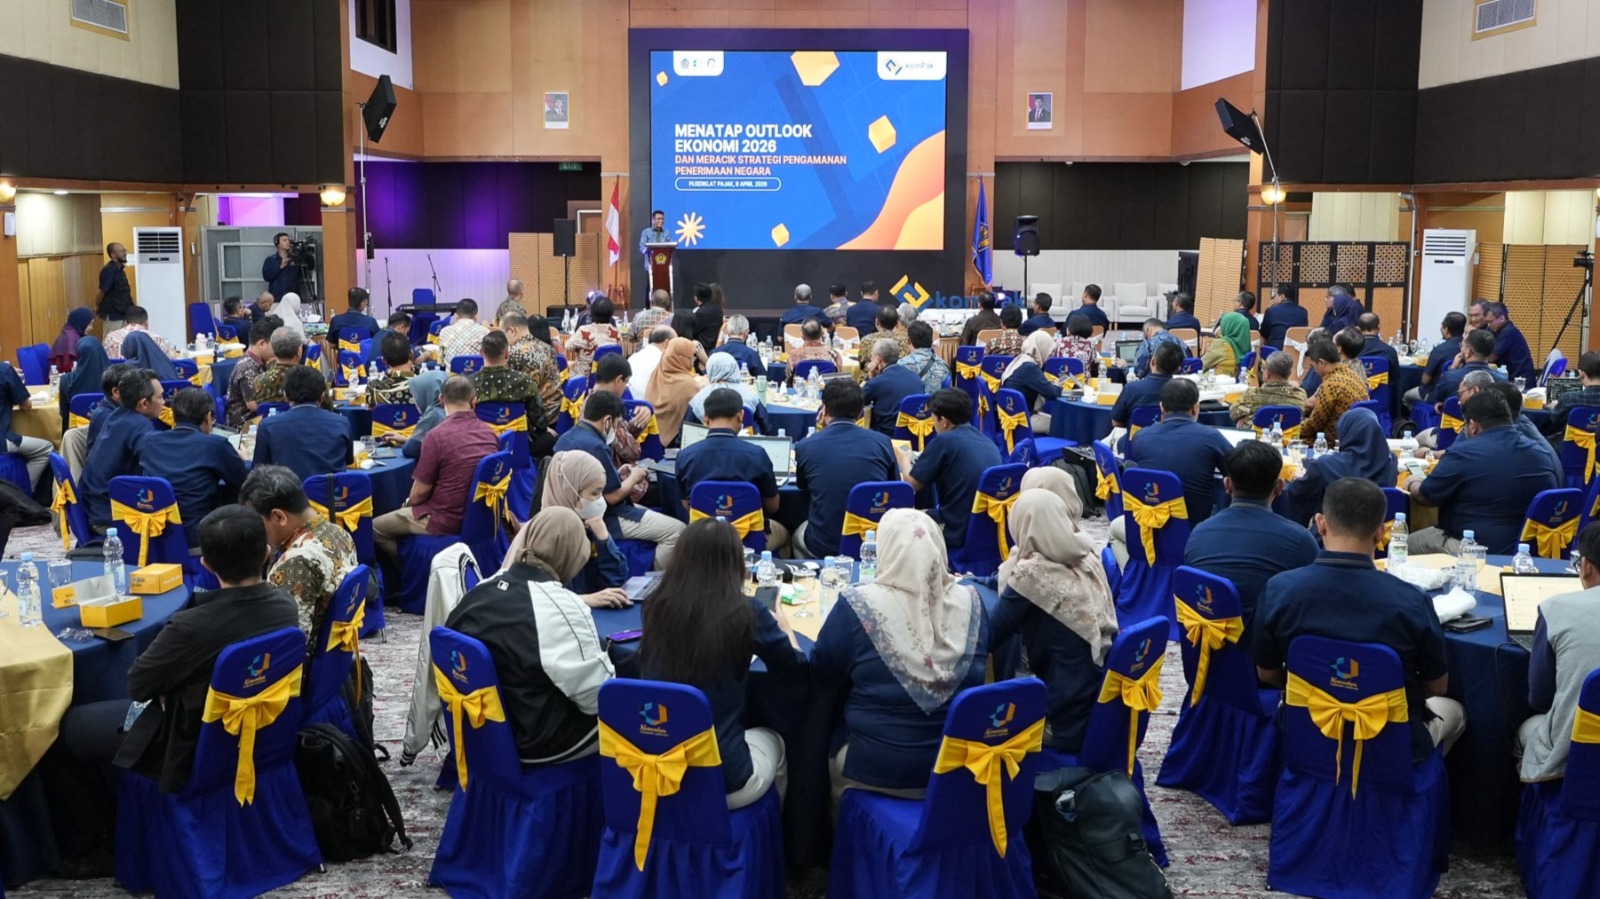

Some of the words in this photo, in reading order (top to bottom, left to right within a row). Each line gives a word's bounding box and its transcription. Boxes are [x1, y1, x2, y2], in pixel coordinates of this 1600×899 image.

[675, 124, 743, 138] MENATAP
[745, 124, 813, 138] OUTLOOK
[675, 139, 739, 153] EKONOMI
[742, 139, 777, 153] 2026
[675, 155, 694, 164] DAN
[696, 155, 736, 164] MERACIK
[738, 155, 781, 164] STRATEGI
[783, 155, 847, 164] PENGAMANAN
[675, 166, 733, 176] PENERIMAAN
[734, 166, 771, 176] NEGARA
[688, 180, 716, 188] PUSDIKLAT
[717, 180, 735, 189] PAJAK,
[740, 180, 754, 188] APRIL
[754, 180, 768, 188] 2026
[935, 290, 1025, 310] komak
